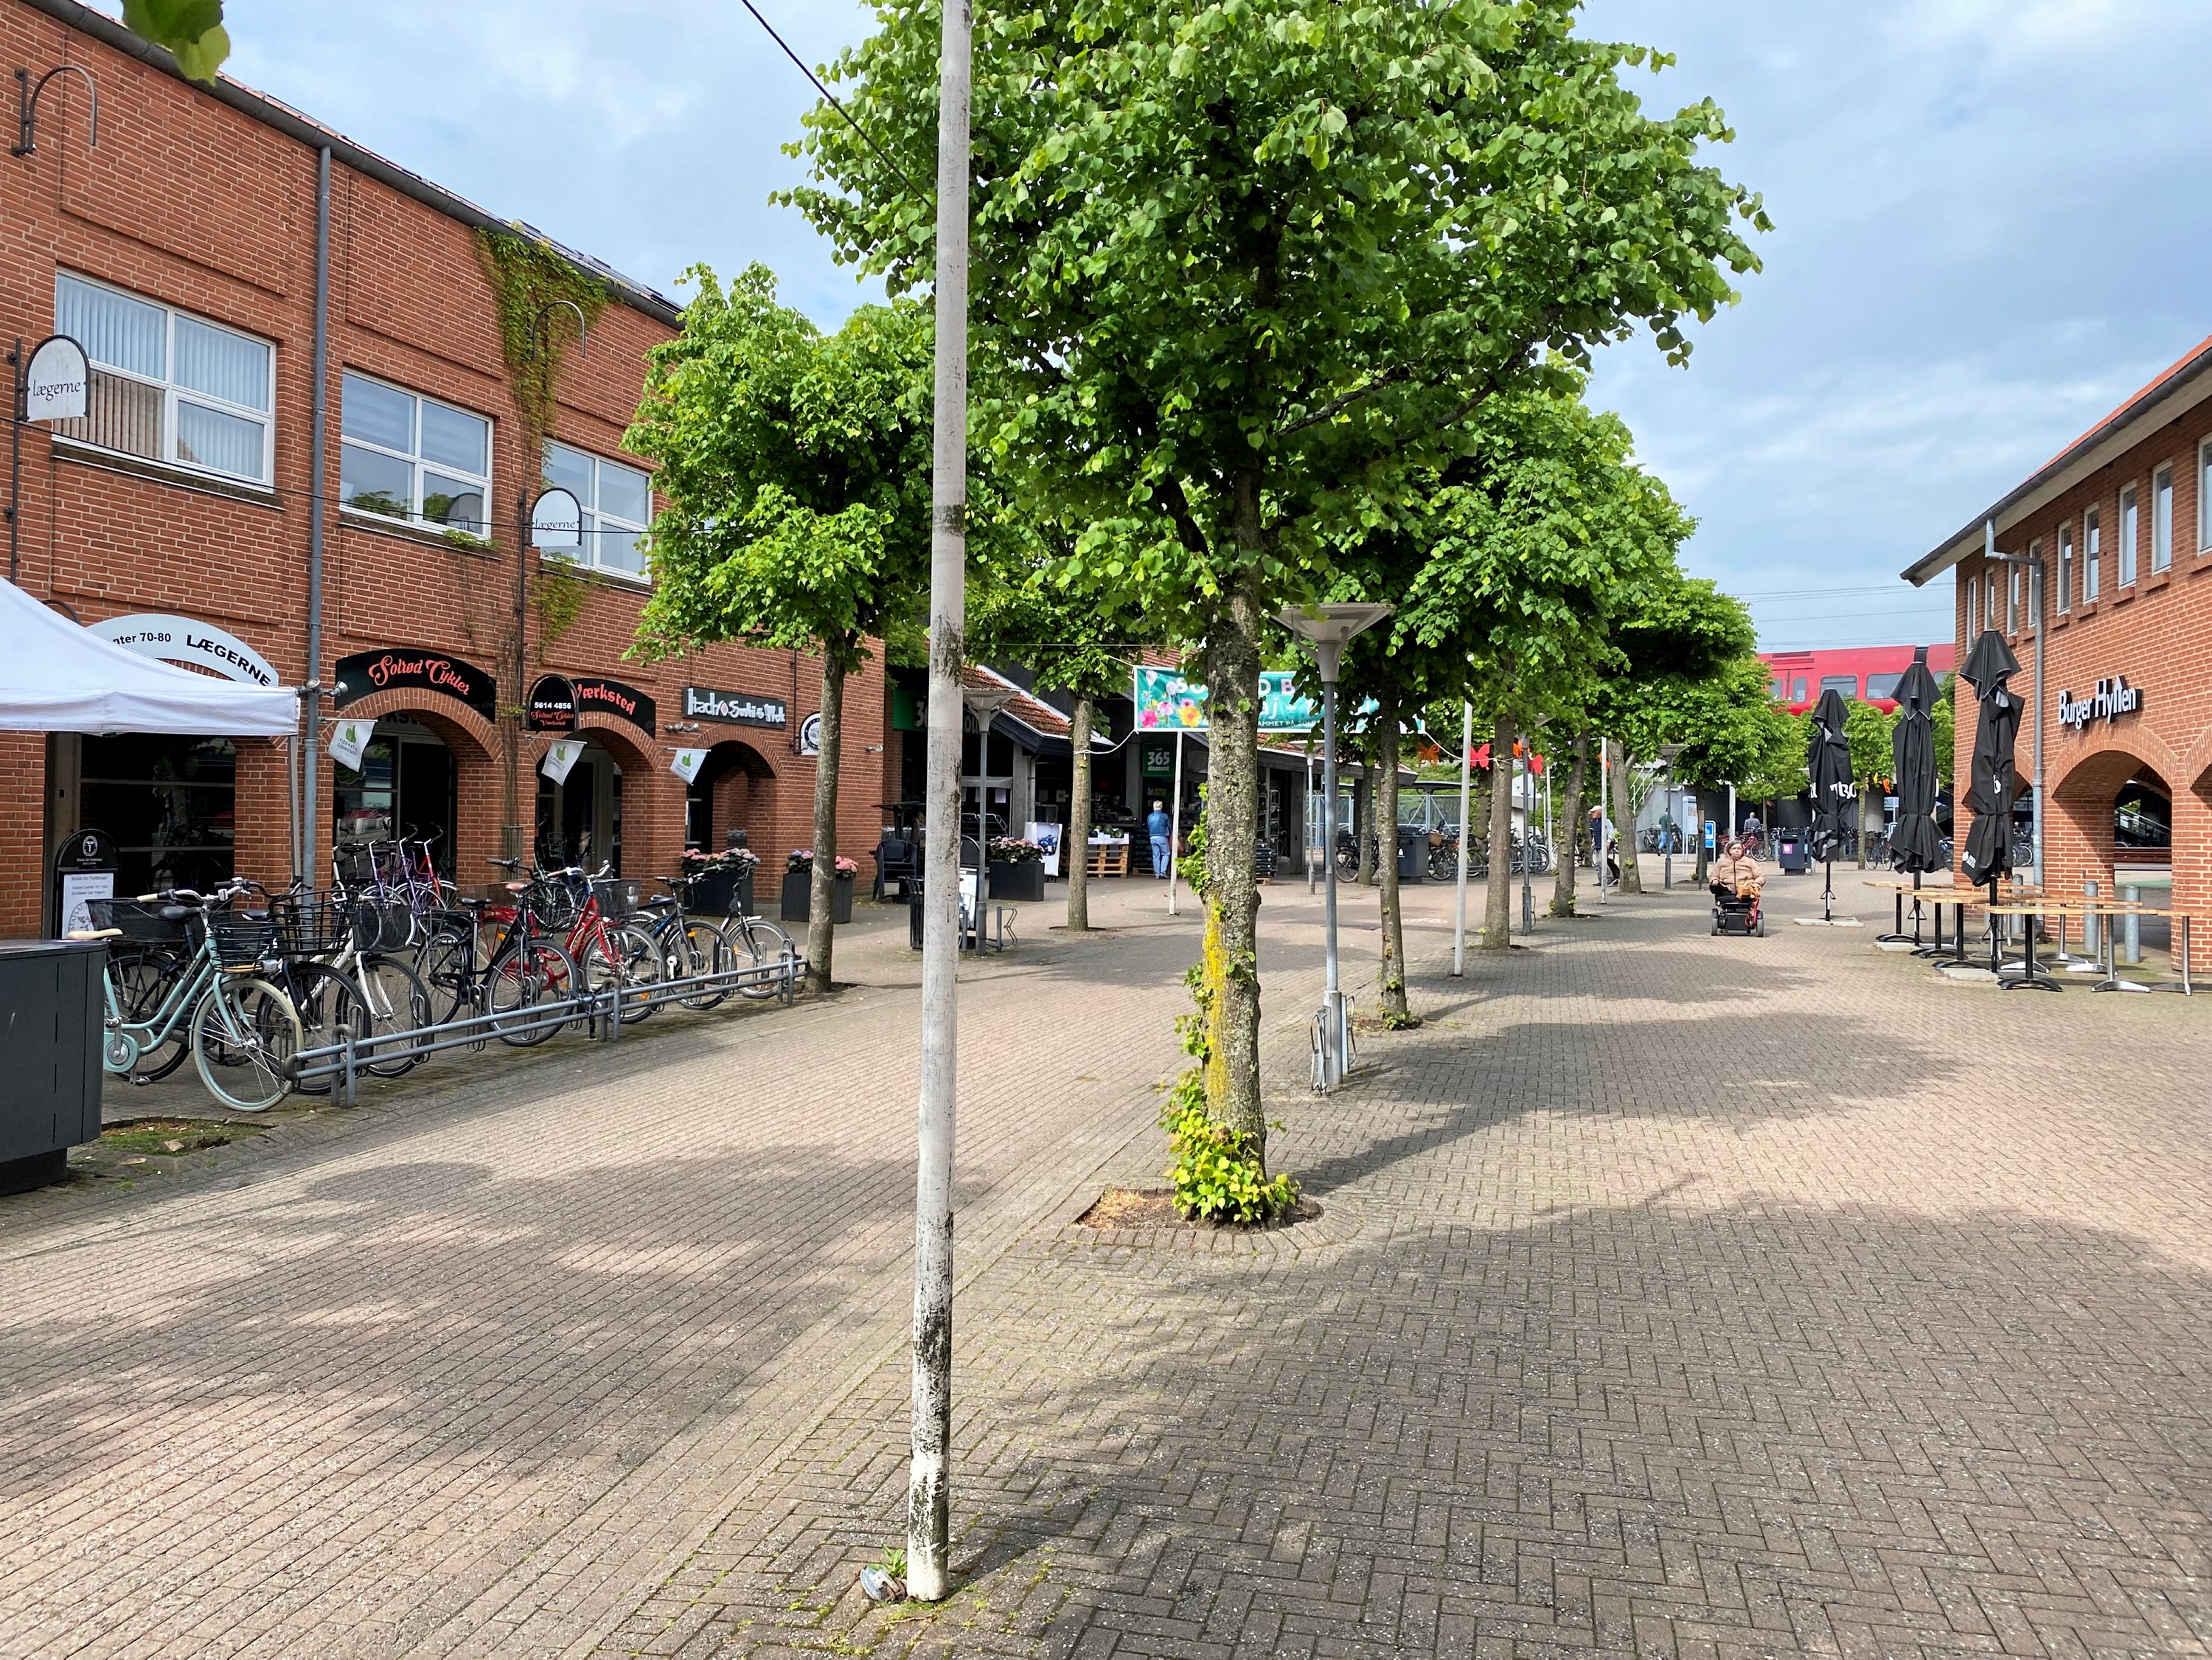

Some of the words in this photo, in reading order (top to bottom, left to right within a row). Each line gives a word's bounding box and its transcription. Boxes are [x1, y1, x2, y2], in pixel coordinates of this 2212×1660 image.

[32, 379, 81, 401] lægerne
[535, 518, 576, 532] lægerne
[139, 632, 171, 642] 70-80
[187, 634, 271, 687] LÆGERNE
[368, 655, 423, 686] Solrød
[425, 659, 470, 695] Cykler
[2058, 690, 2093, 730] Burger
[1148, 751, 1170, 765] 365
